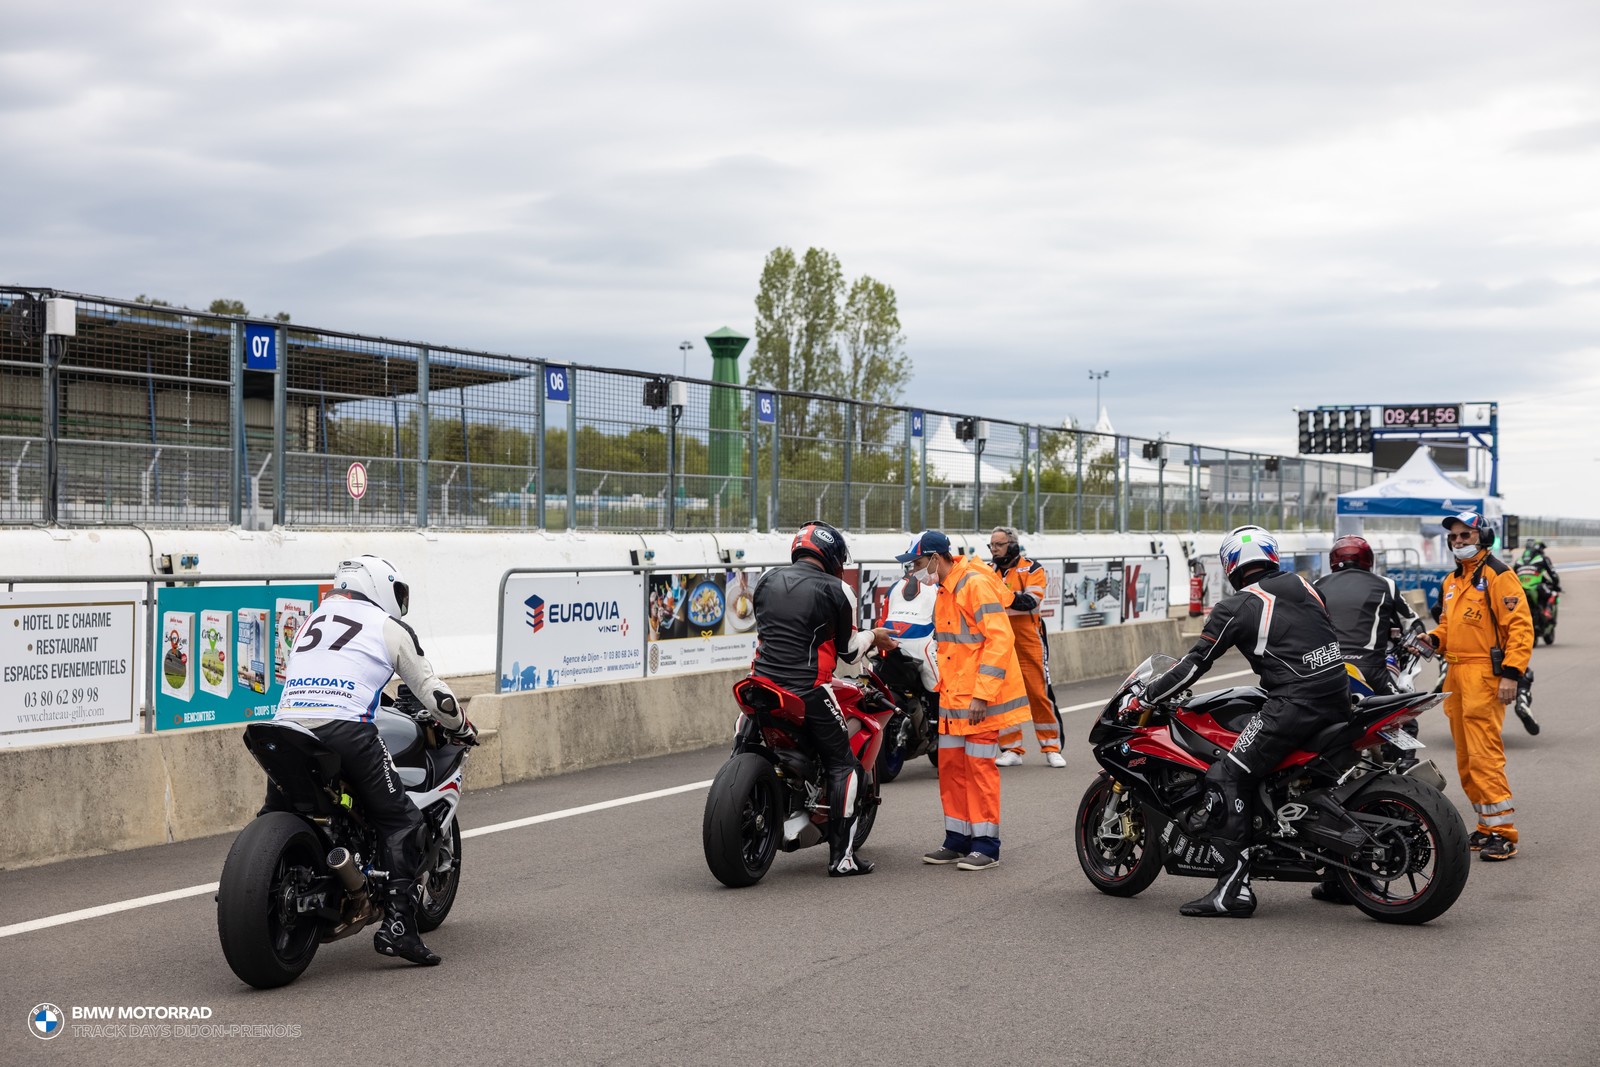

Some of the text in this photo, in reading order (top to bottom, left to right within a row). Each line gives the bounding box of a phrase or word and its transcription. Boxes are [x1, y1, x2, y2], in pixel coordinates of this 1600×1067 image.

[252, 335, 270, 358] 07
[550, 372, 564, 391] 06
[760, 398, 771, 415] 05
[913, 416, 922, 430] 04
[1384, 408, 1456, 424] 09:41:56
[548, 600, 620, 623] EUROVIA
[23, 612, 112, 631] HOTEL DE CHARME
[598, 624, 620, 633] VINCI
[295, 614, 363, 653] 57
[36, 637, 99, 655] RESTAURANT
[563, 655, 581, 665] Agence
[581, 653, 587, 662] de
[587, 652, 600, 663] Dijon
[4, 659, 126, 682] ESPACES EVENEMENTIELS
[24, 686, 99, 708] 03 80 62 89 98
[17, 704, 105, 724] www.chateau-gilly.com
[183, 710, 216, 723] RENCONTRES
[254, 705, 270, 716] COUPS
